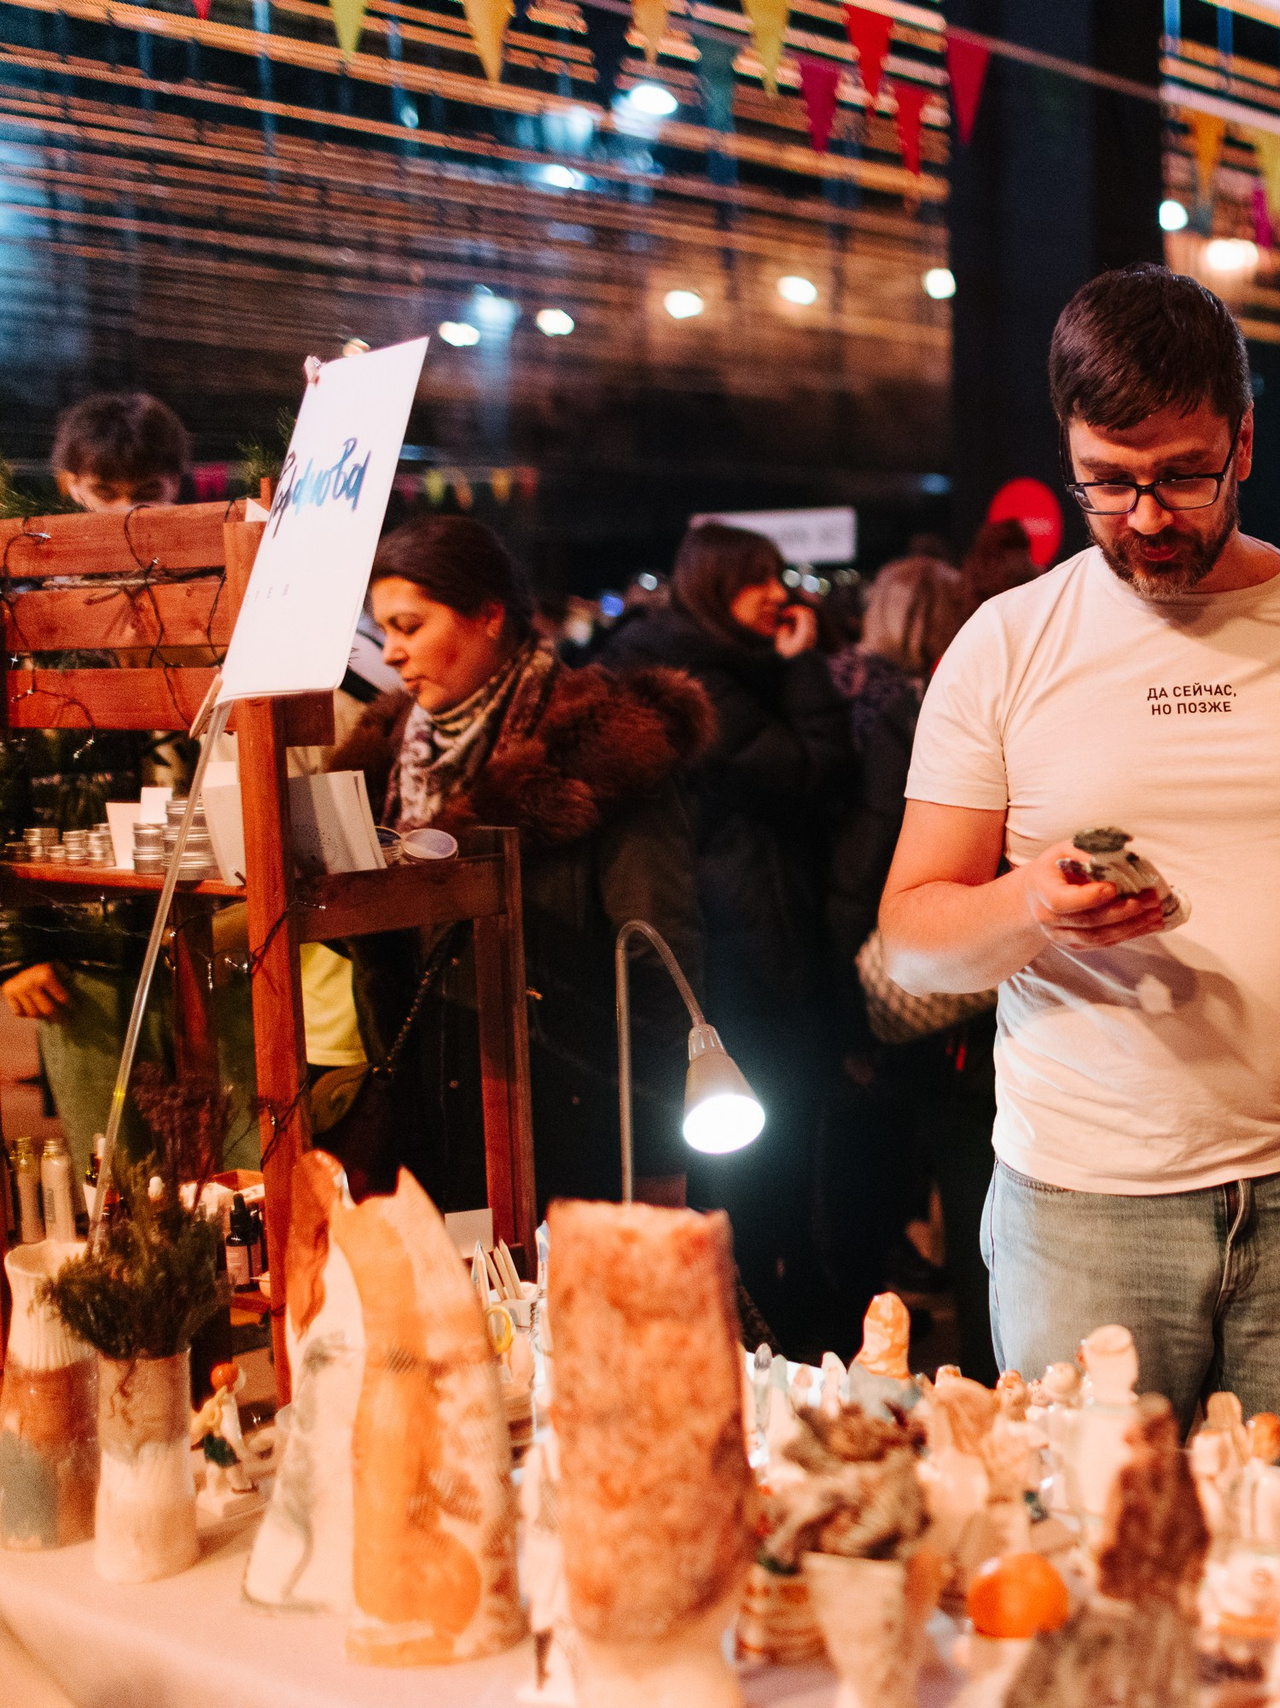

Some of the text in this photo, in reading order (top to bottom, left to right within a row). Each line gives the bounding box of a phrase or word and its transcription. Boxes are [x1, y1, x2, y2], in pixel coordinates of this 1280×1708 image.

[1147, 682, 1237, 701] ДА СЕЙЧАС,
[1151, 701, 1232, 715] НО ПОЗЖЕ
